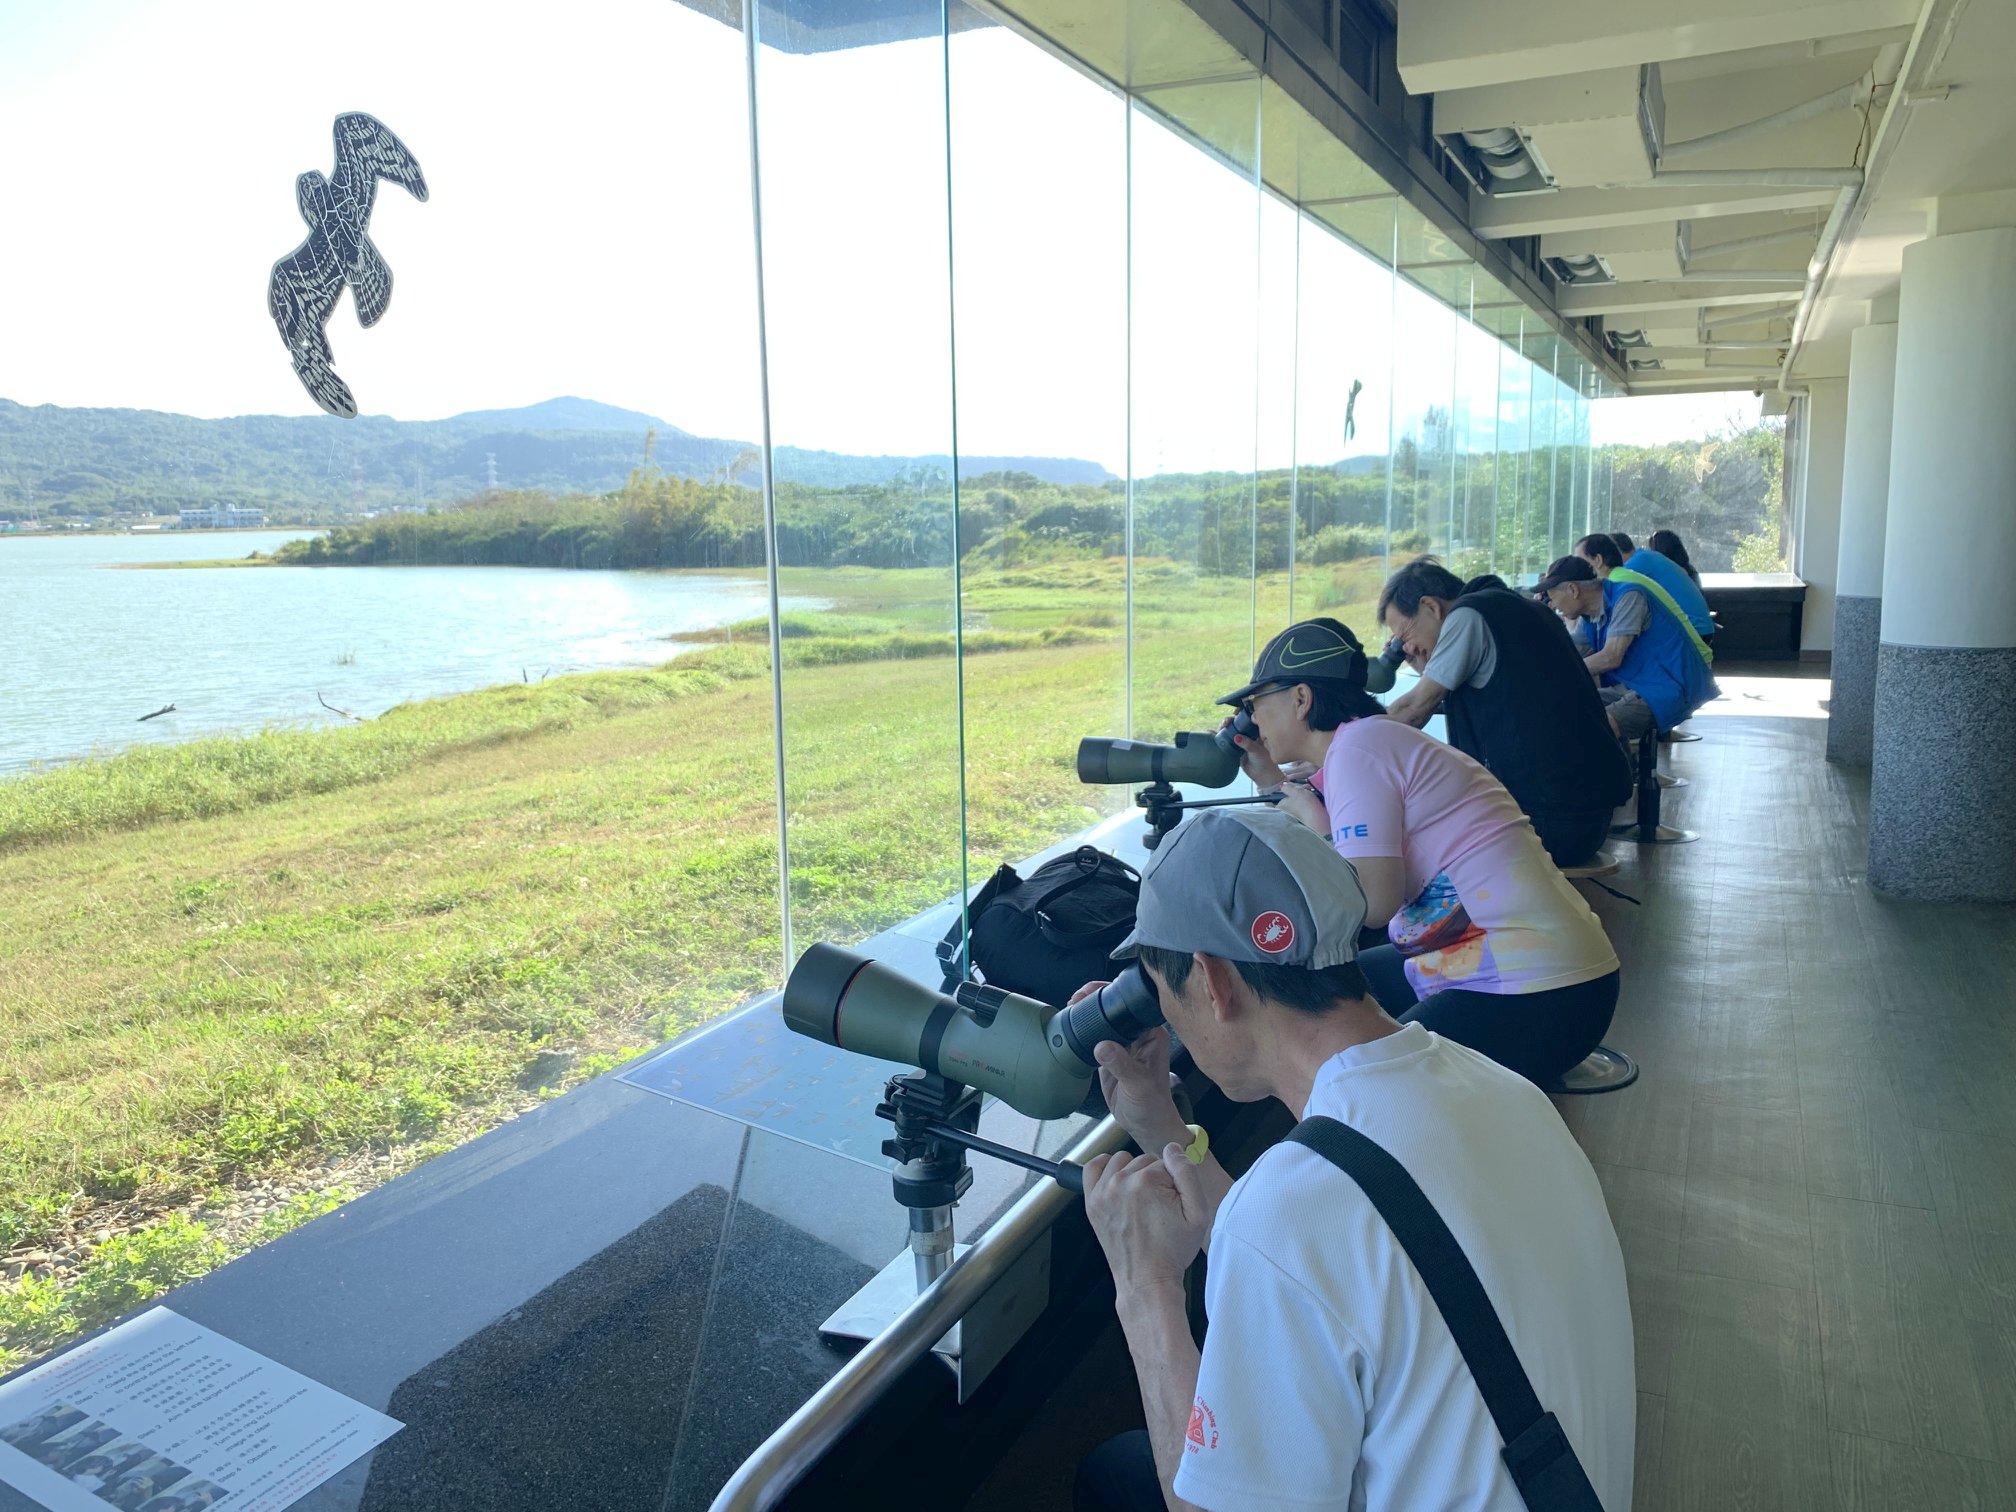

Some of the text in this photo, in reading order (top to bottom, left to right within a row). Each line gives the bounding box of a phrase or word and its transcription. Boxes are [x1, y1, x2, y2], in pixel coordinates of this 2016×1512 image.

[124, 1369, 139, 1377] the
[137, 1361, 154, 1371] grip
[165, 1412, 184, 1422] Aim
[188, 1400, 204, 1409] the
[221, 1380, 238, 1390] and
[212, 1434, 231, 1446] Turn
[229, 1427, 243, 1436] the
[241, 1419, 259, 1429] ring
[262, 1403, 283, 1415] focus
[294, 1387, 308, 1395] the
[1210, 1430, 1218, 1449] Club
